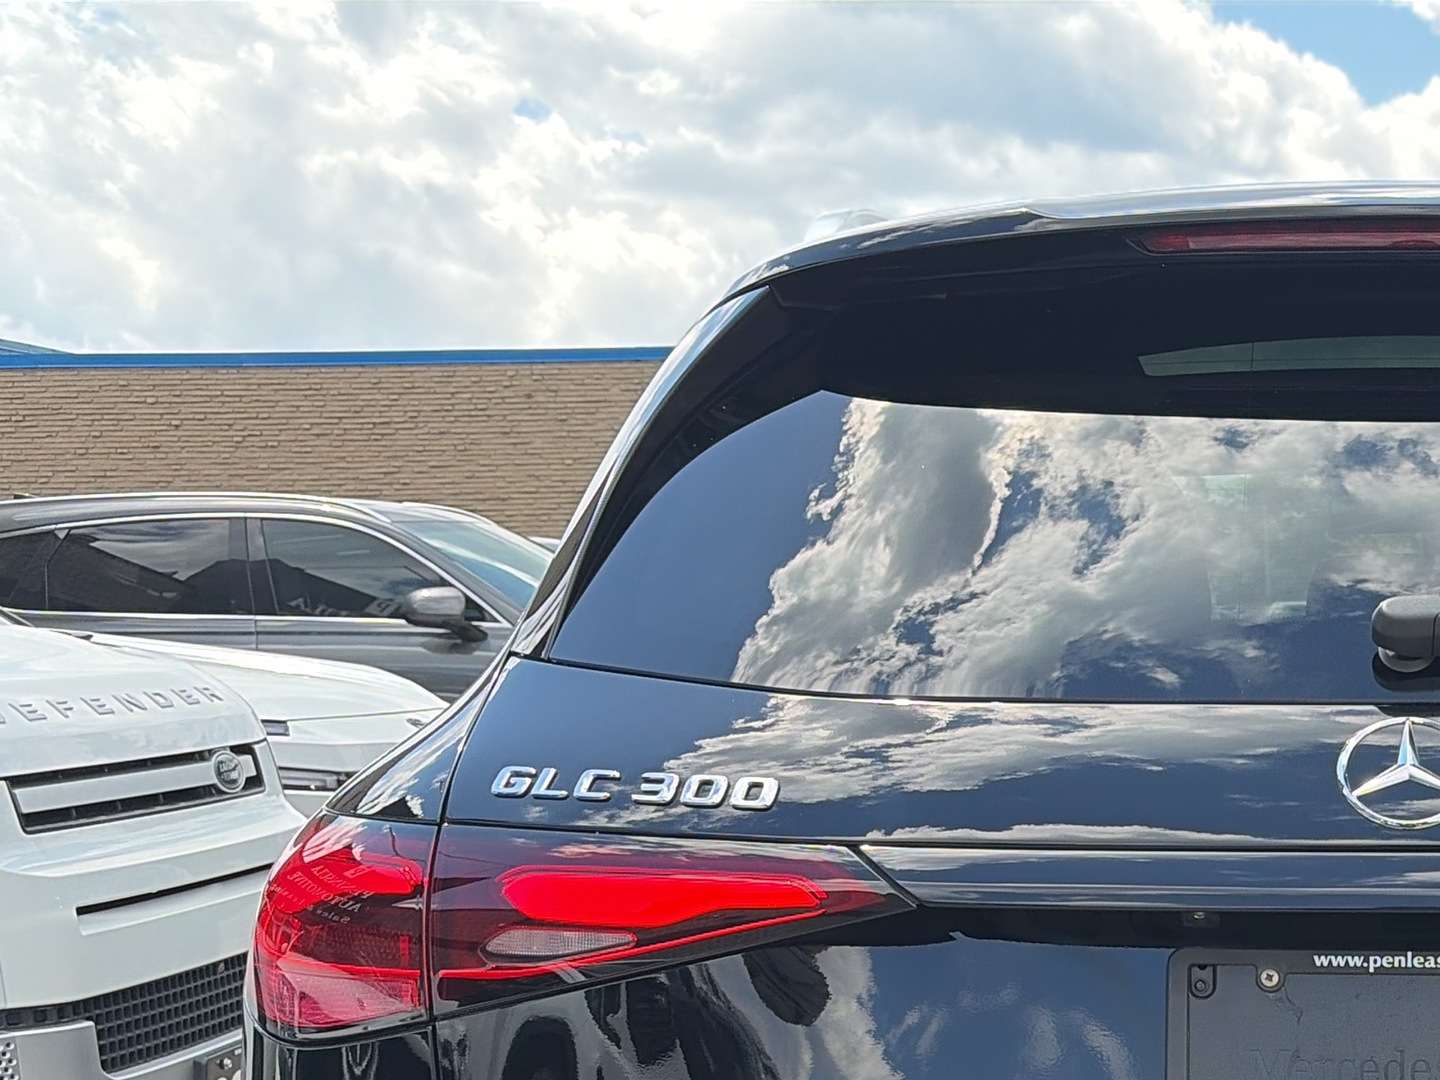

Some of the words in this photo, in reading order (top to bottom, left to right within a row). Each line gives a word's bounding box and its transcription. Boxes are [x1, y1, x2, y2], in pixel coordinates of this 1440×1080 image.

[0, 686, 223, 724] EFENDER
[489, 766, 621, 800] GLC
[631, 772, 781, 810] 300
